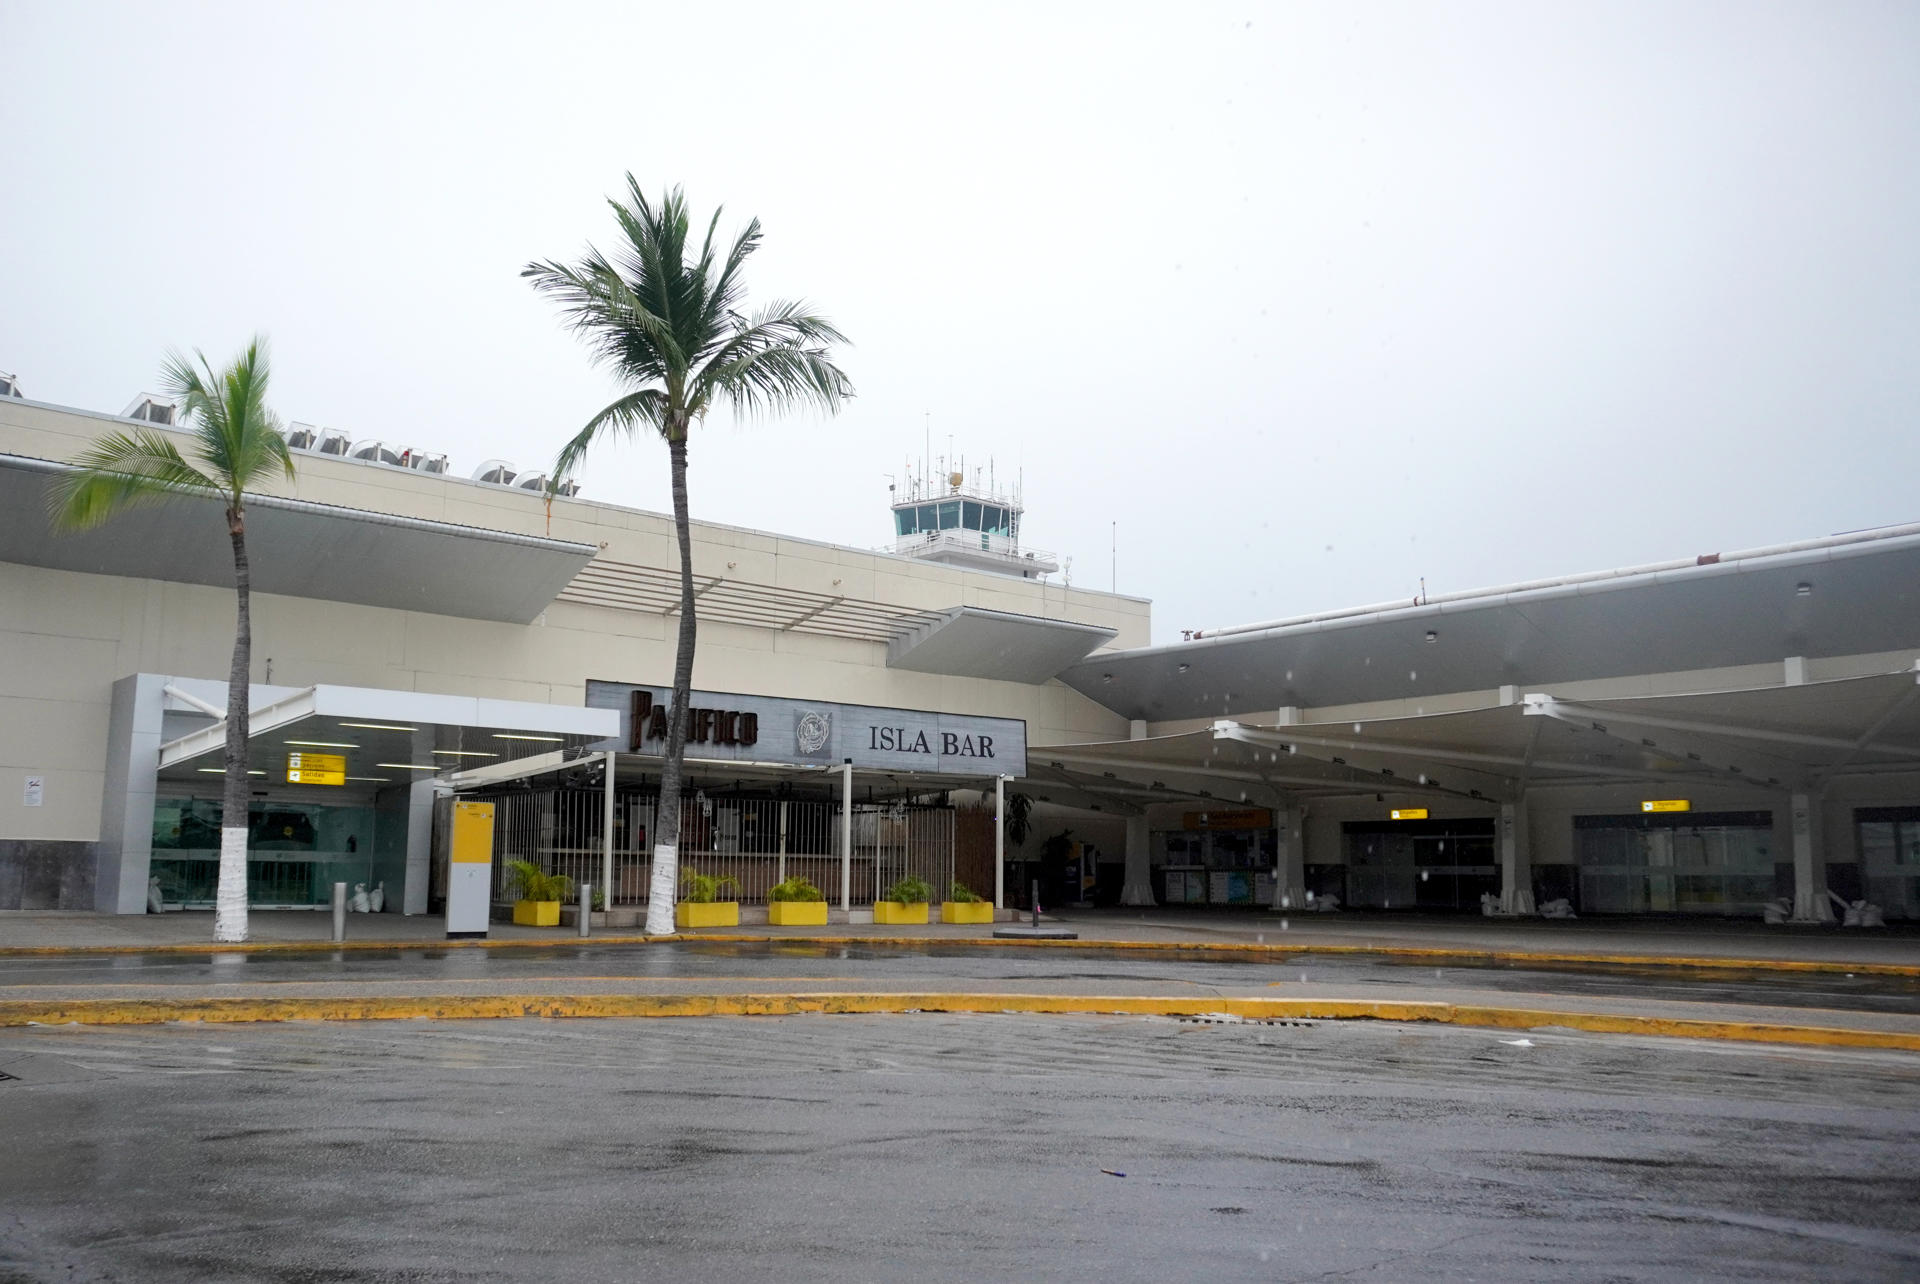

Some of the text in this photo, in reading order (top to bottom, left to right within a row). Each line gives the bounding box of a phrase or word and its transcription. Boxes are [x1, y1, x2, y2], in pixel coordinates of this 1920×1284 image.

[629, 690, 759, 752] PAIFICO
[868, 726, 996, 758] ISLA BAR
